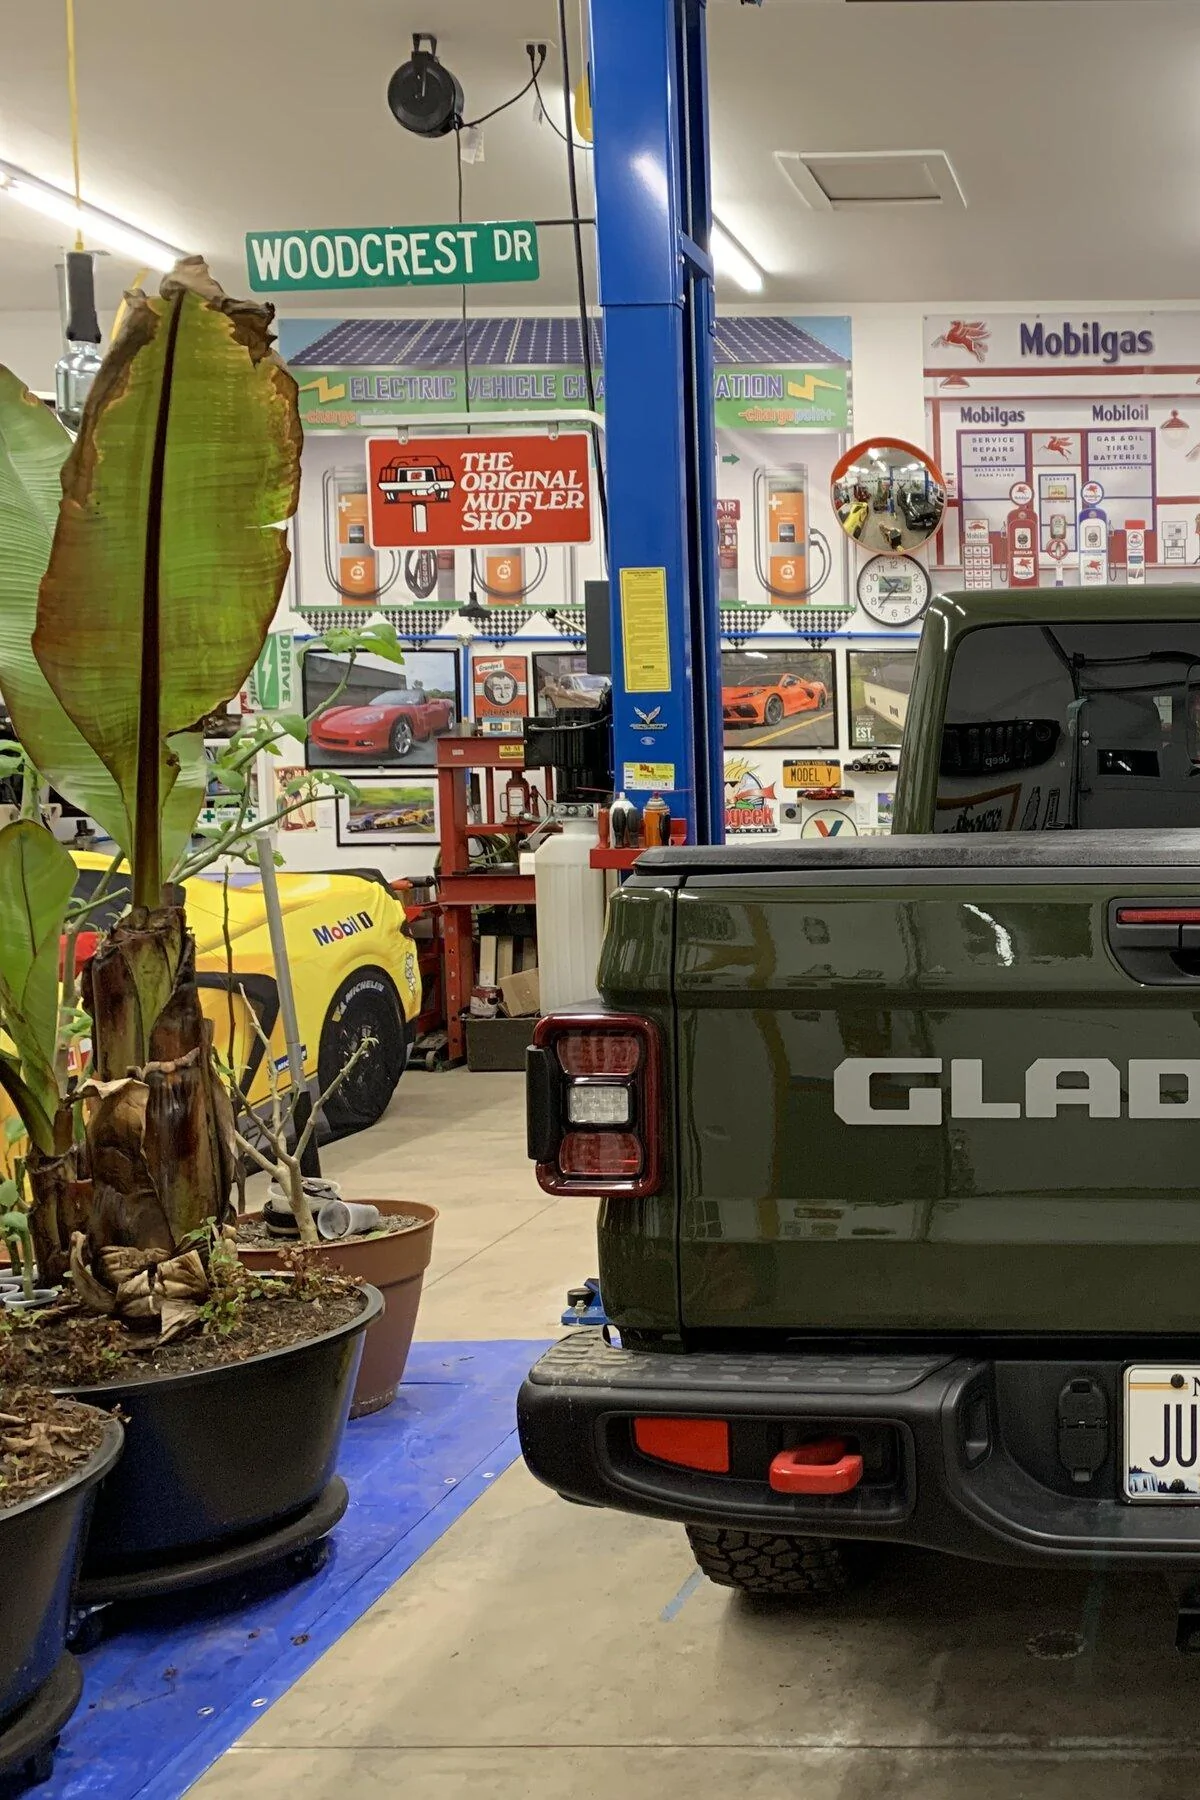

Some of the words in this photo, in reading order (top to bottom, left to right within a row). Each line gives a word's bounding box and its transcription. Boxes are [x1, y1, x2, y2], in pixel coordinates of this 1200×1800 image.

[251, 230, 479, 280] WOODCREST
[494, 229, 533, 261] DR
[1020, 322, 1154, 363] Mobilgas
[350, 375, 456, 400] ELECTRIC
[465, 374, 557, 400] VEHICLE
[715, 374, 784, 399] ATION
[960, 406, 1025, 427] Mobilgas
[1092, 404, 1149, 421] Mobiloil
[971, 436, 1015, 444] SERVICE
[460, 452, 513, 472] THE
[1093, 453, 1149, 461] BATTERIES
[460, 471, 583, 491] ORIGINAL
[461, 491, 586, 512] MUFFLER
[716, 503, 736, 511] AIR
[461, 511, 532, 531] SHOP
[279, 635, 292, 703] DRIVE
[856, 727, 875, 739] EST.
[790, 768, 820, 782] MODEL
[826, 768, 833, 782] Y
[312, 915, 362, 946] Mobil
[345, 979, 385, 1003] MICHELIN
